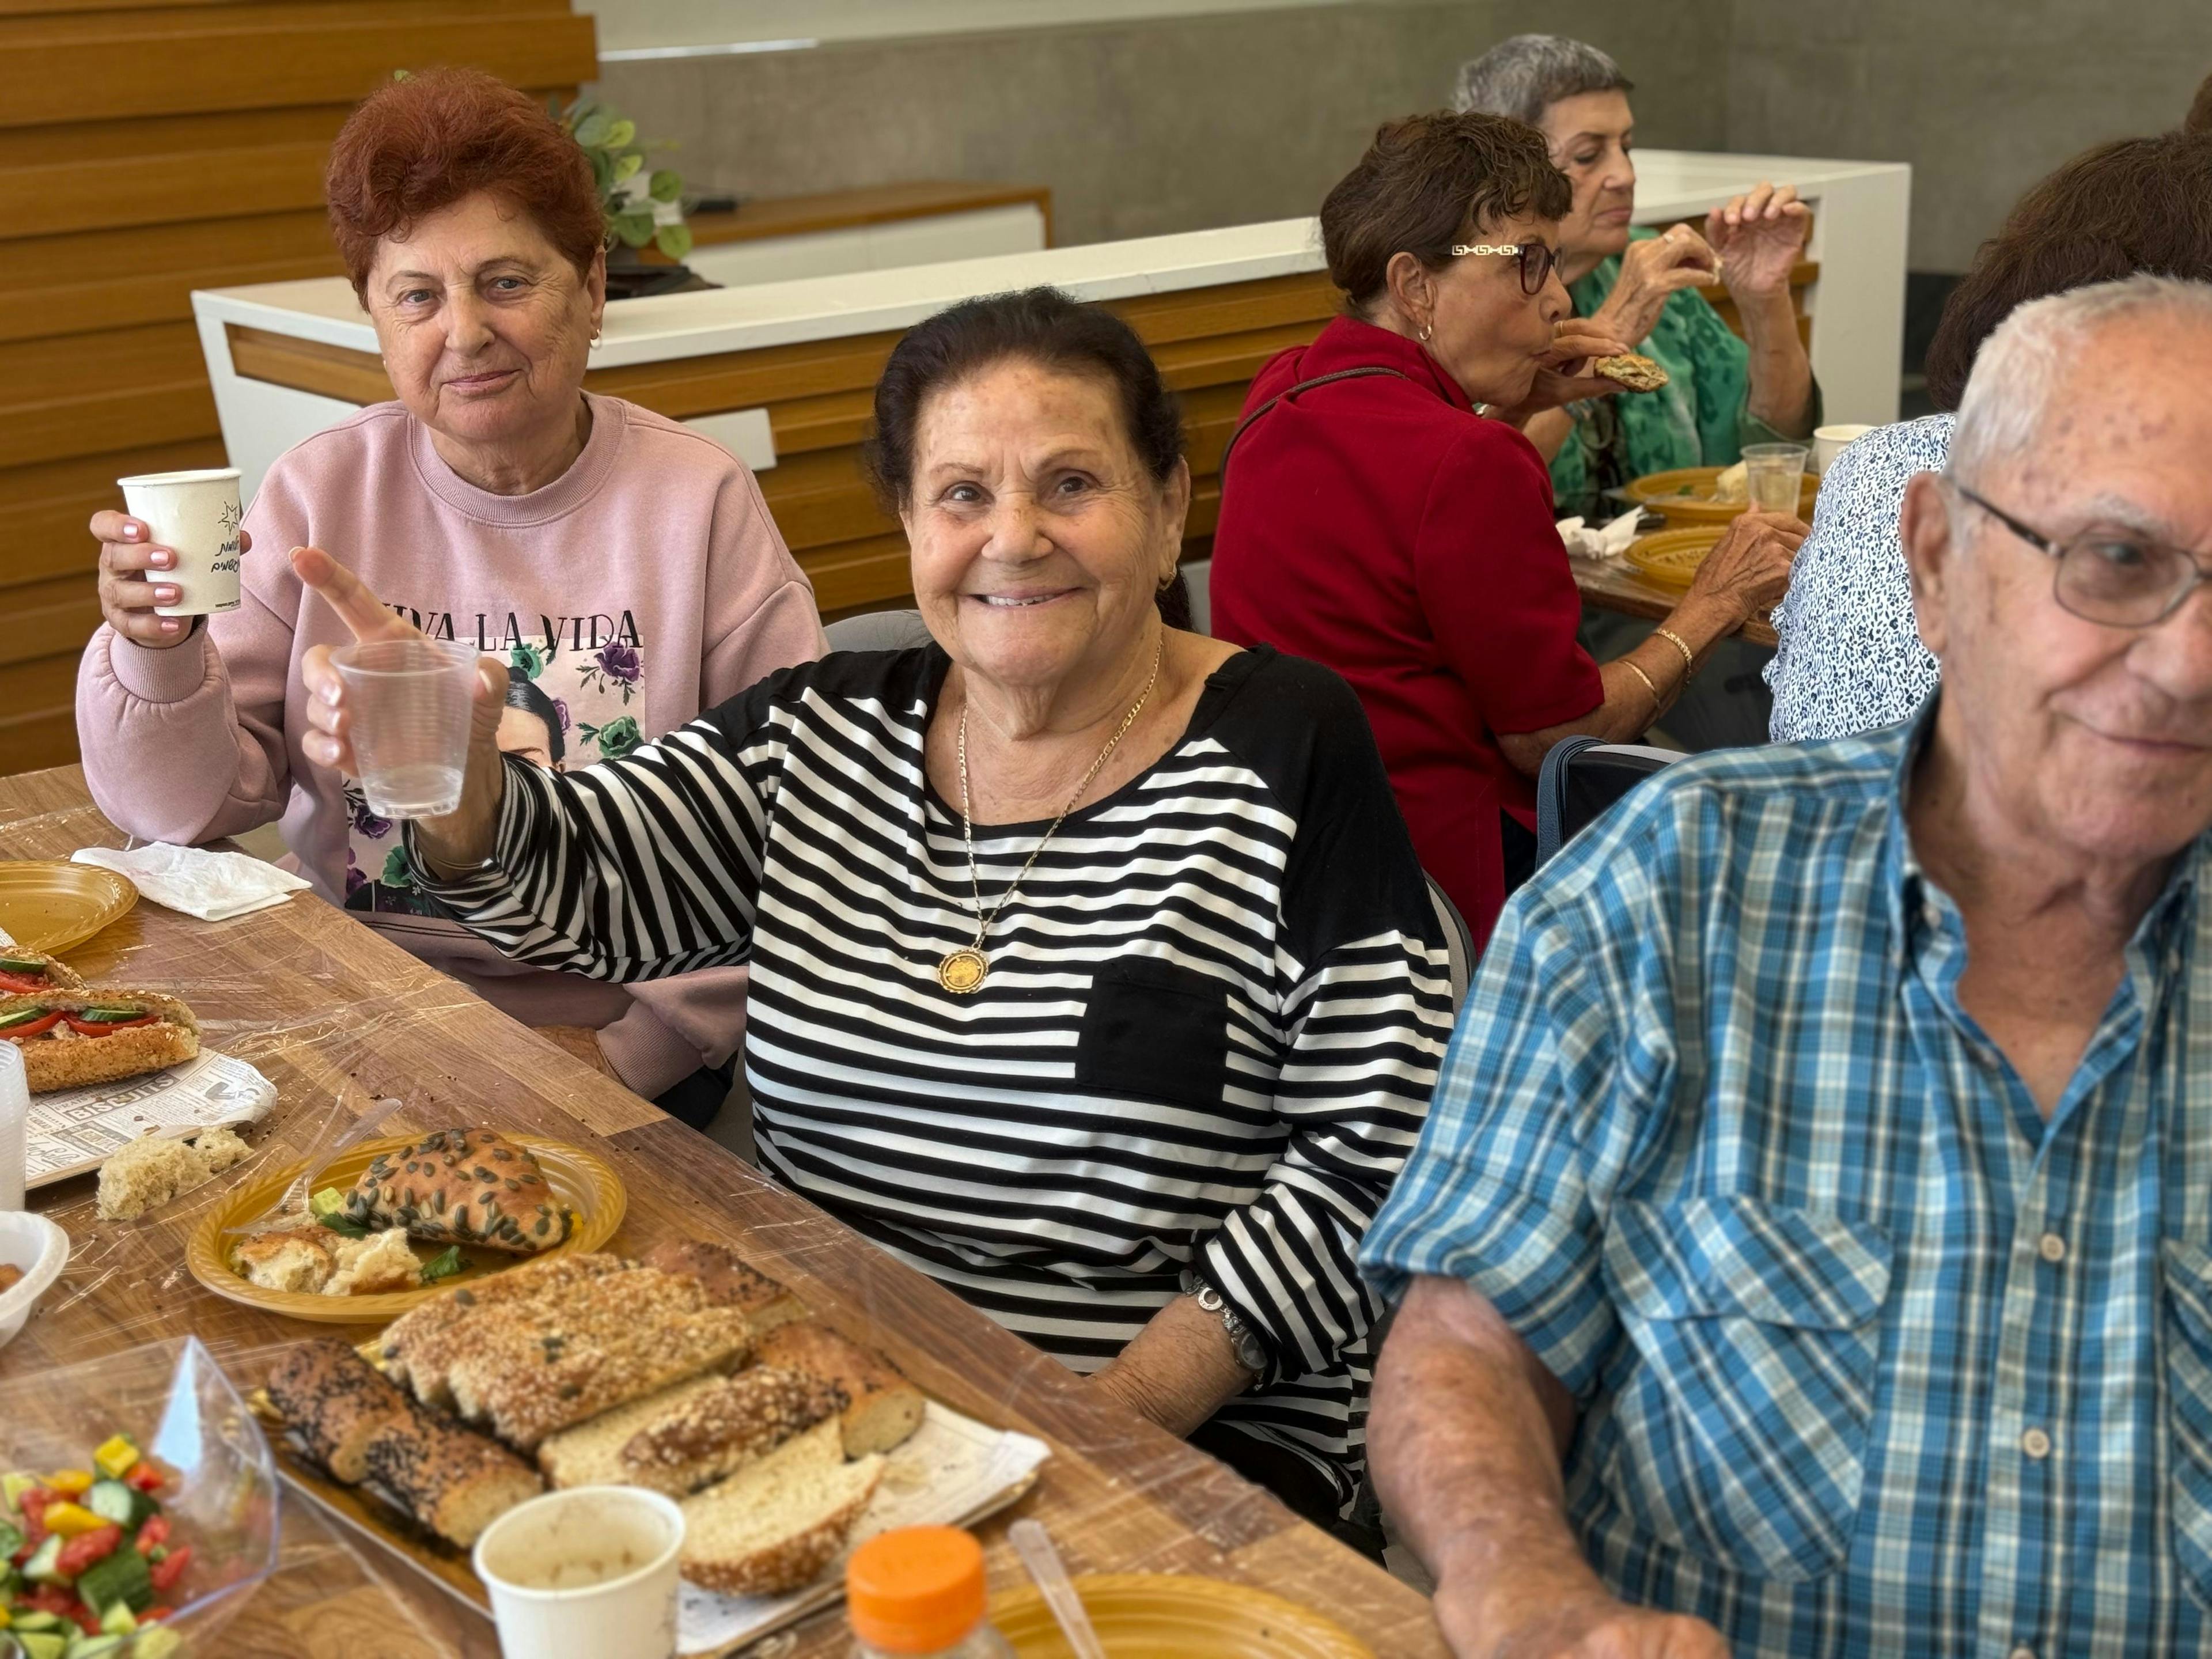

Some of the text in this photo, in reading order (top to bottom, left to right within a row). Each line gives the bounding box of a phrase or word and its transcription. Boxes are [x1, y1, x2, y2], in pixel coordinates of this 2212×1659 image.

[382, 603, 643, 651] VA LA VIDA
[67, 1075, 174, 1118] BISCUITS
